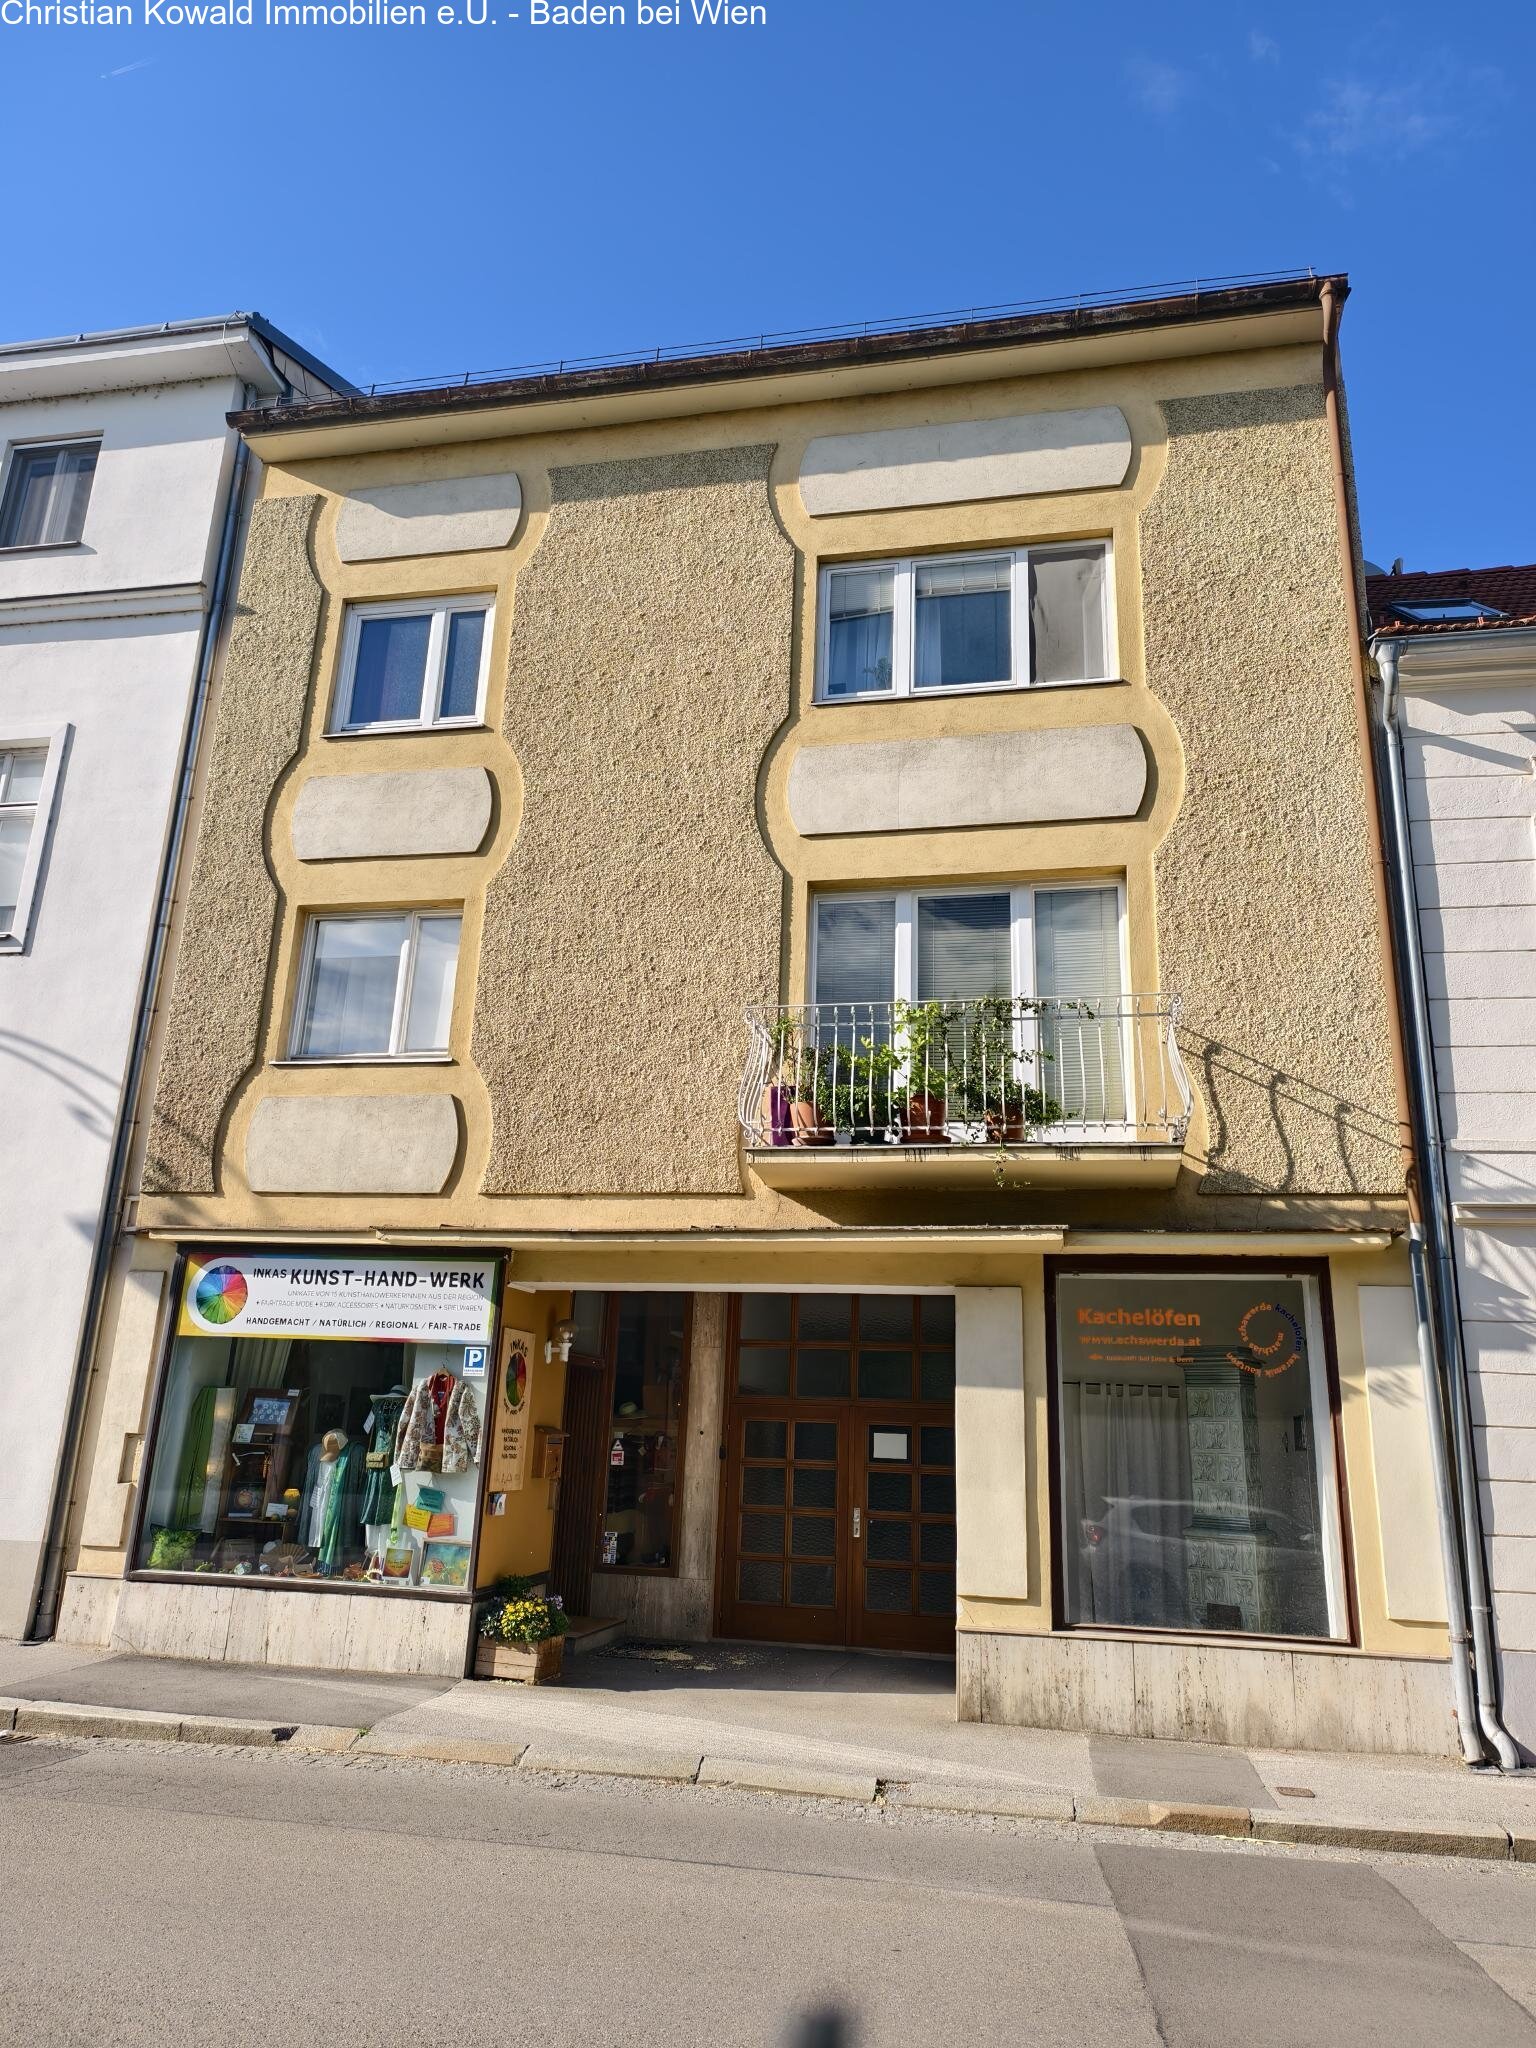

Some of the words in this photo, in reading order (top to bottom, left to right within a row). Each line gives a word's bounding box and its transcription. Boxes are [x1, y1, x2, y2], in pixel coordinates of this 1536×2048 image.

[253, 1268, 287, 1278] INKAS
[290, 1269, 484, 1288] KUNST-HAND-WERK
[287, 1290, 315, 1298] UNIKATE
[315, 1290, 330, 1298] VON
[443, 1293, 457, 1301] DER
[443, 1304, 483, 1312] SPIELWAREN
[246, 1317, 310, 1326] HANDGEMACHT
[319, 1318, 367, 1328] NATÜRLICH
[375, 1321, 419, 1329] REGIONAL
[428, 1322, 481, 1331] FAIR-TRADE
[1077, 1308, 1200, 1326] Kachelöfen
[468, 1350, 482, 1366] P
